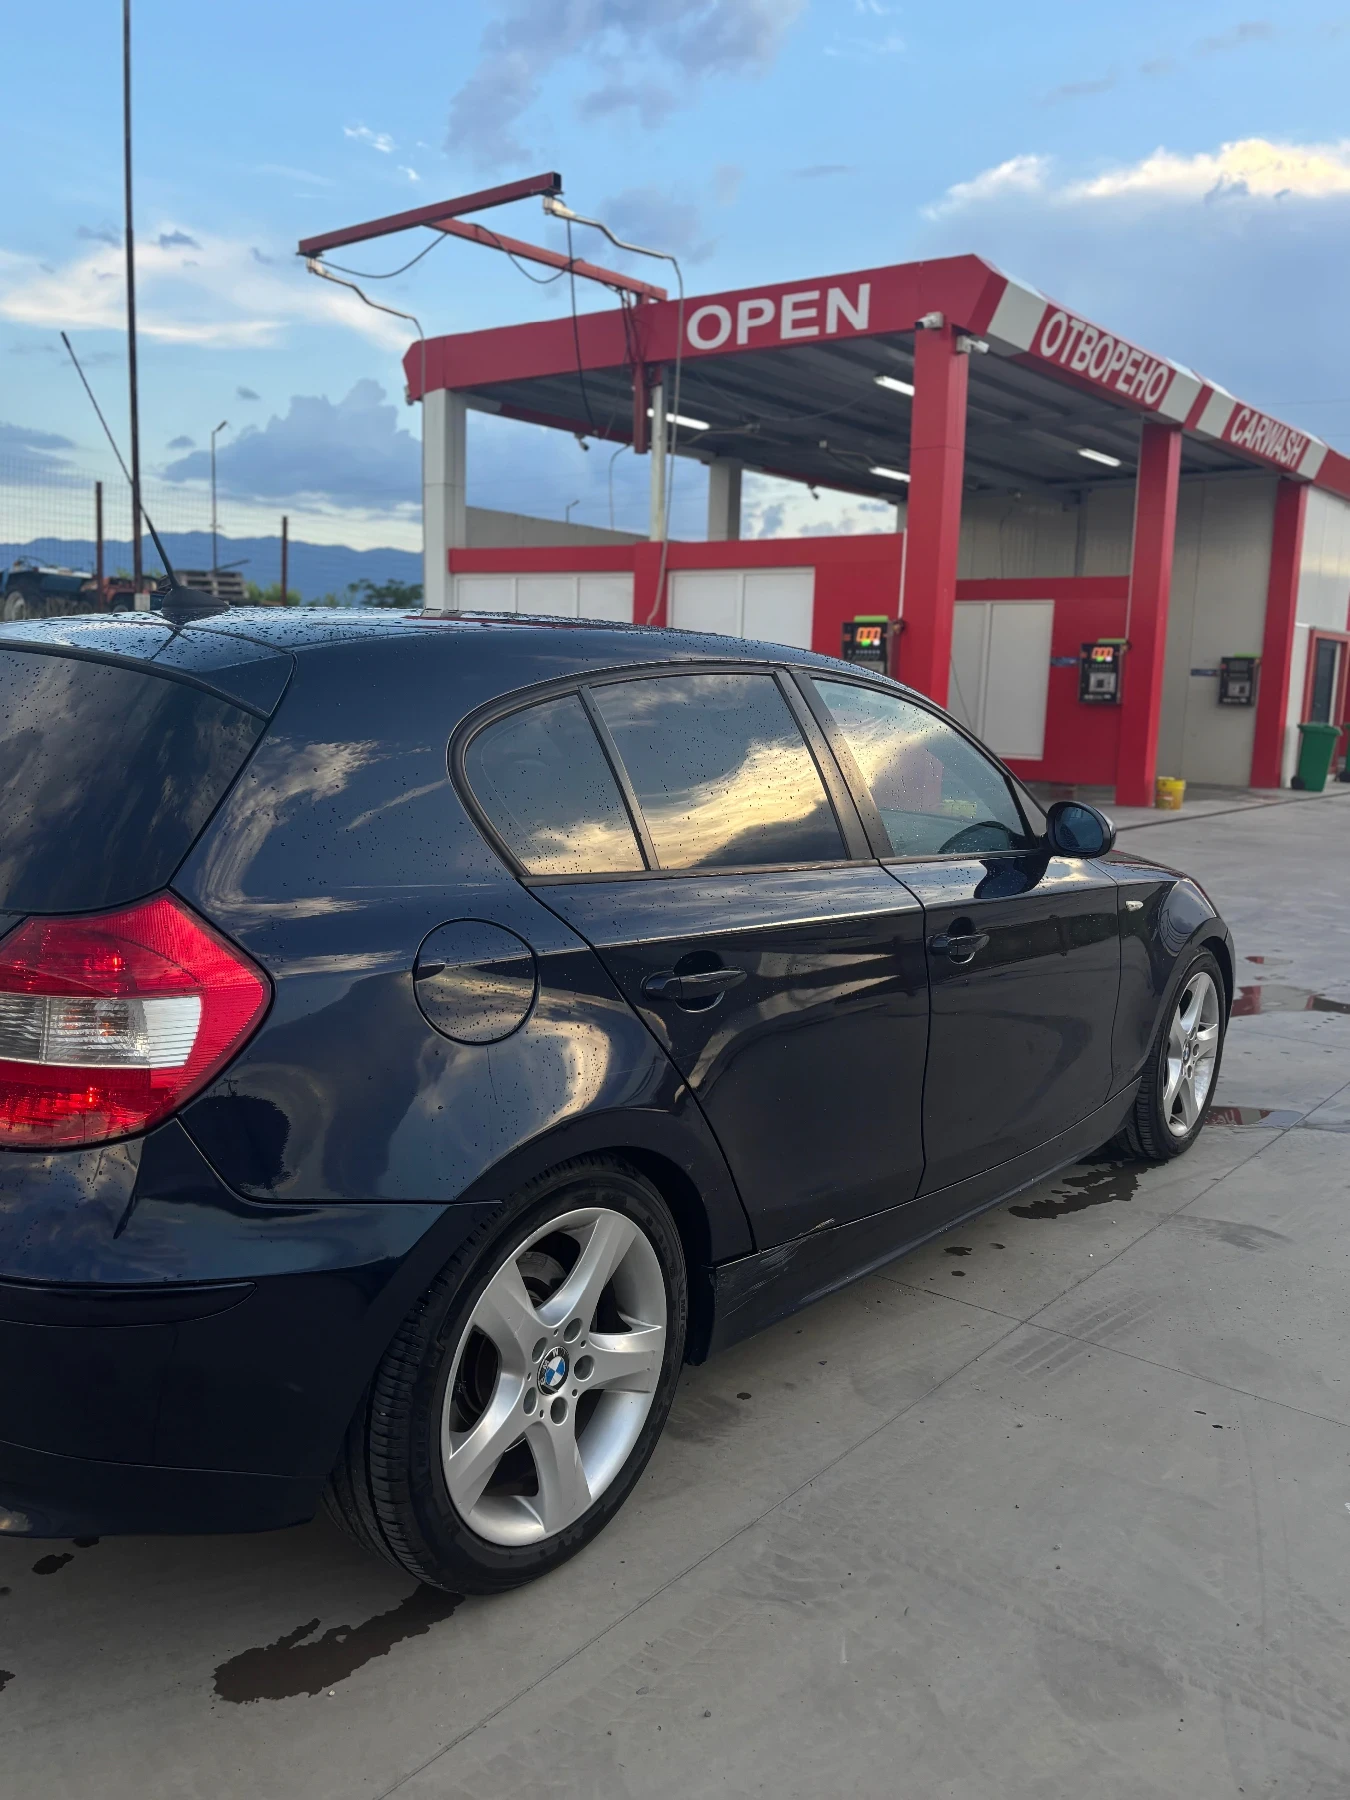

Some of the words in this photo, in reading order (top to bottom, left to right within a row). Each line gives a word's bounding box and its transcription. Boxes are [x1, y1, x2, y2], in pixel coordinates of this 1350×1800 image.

[687, 283, 871, 350] OPEN
[1040, 311, 1169, 404] ОТВОРЕНО
[1230, 407, 1308, 467] CARWASH
